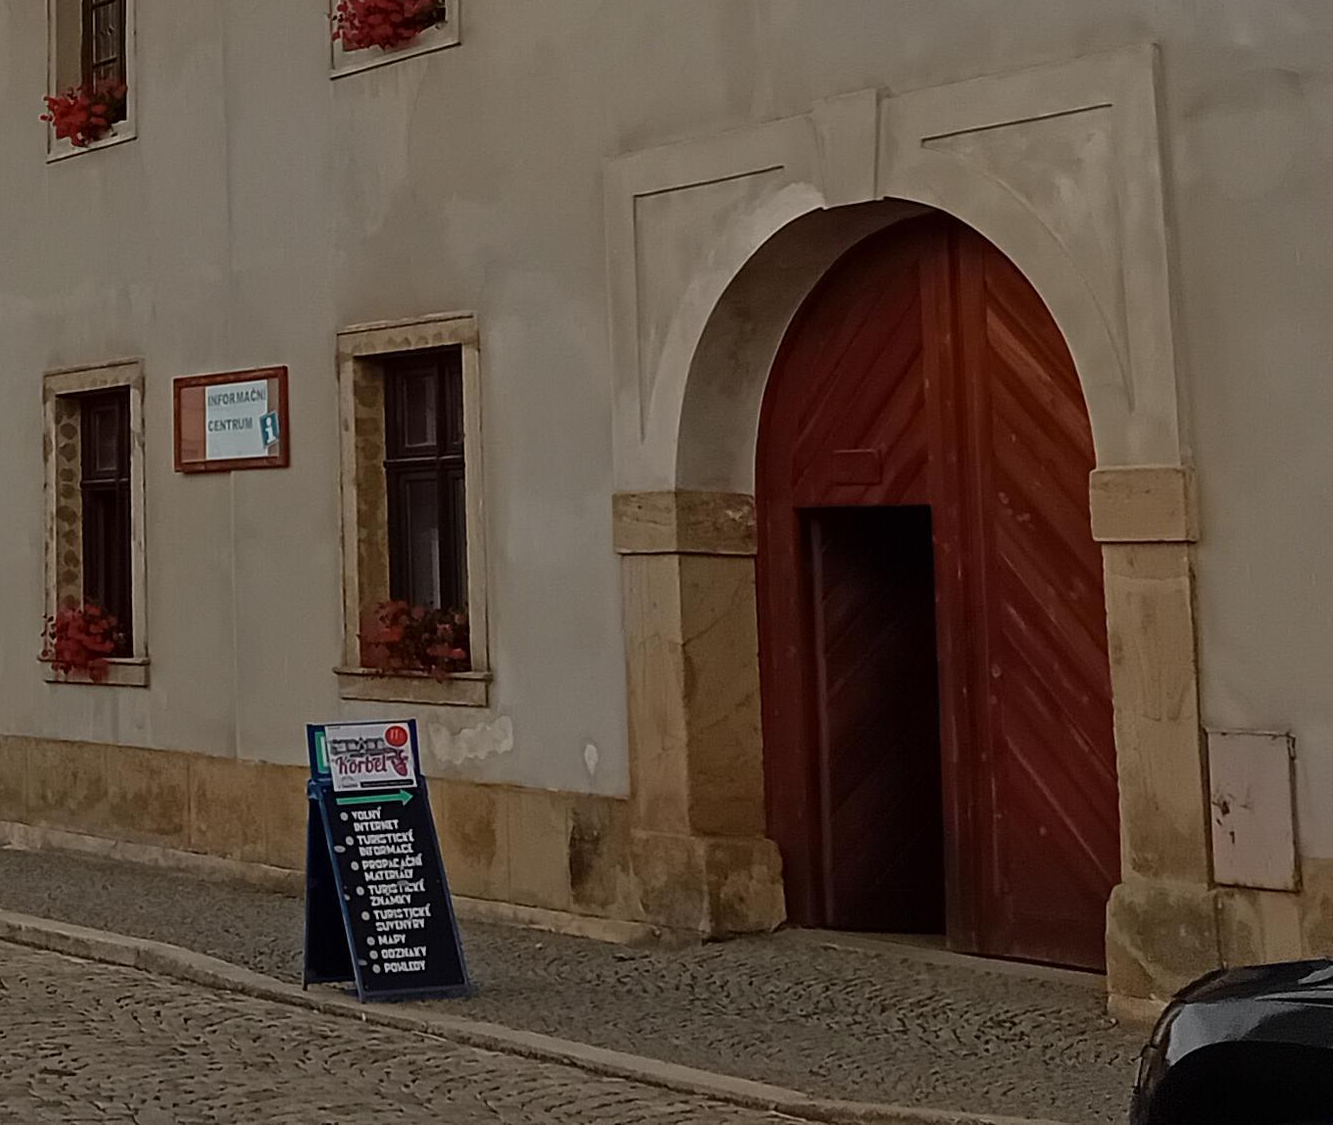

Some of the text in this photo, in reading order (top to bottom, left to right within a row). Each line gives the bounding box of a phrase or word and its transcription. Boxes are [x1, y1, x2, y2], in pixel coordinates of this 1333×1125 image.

[208, 417, 253, 432] CENTRUM
[351, 806, 381, 820] VOLNÝ
[353, 819, 399, 832] INTERNET
[356, 829, 414, 845] TURISTICKÉ
[358, 843, 414, 856] INFORMACE
[377, 934, 406, 945] MAPY
[381, 946, 427, 959] ODZNAKY
[384, 960, 426, 973] POHLEDY
